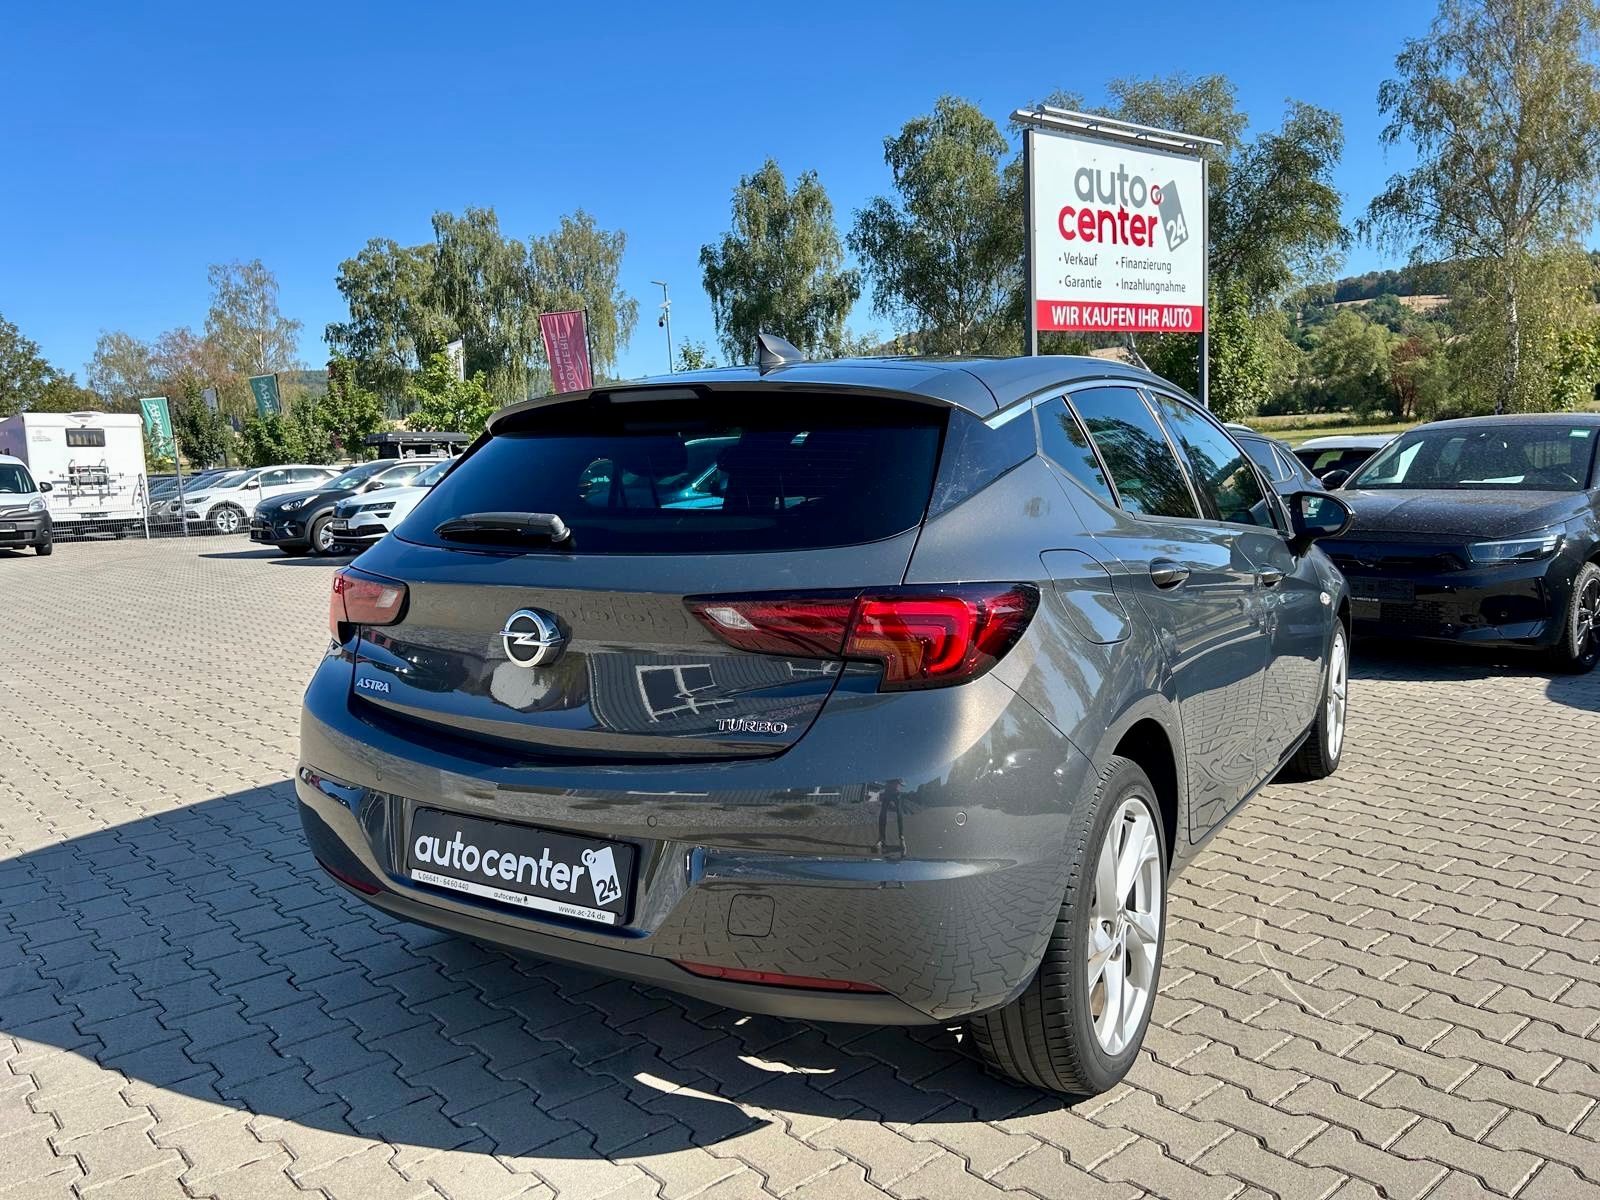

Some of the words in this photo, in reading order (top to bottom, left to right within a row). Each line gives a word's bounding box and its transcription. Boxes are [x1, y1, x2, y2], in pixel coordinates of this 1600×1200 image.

[1074, 163, 1147, 208] auto
[1058, 204, 1157, 247] center
[1166, 213, 1187, 248] 24
[1063, 252, 1098, 267] Verkauf
[1121, 257, 1171, 274] Finanzierung
[1065, 275, 1102, 288] Garantie
[1121, 278, 1186, 294] Inzahlungnahme
[1052, 305, 1079, 326] WIR
[1083, 306, 1135, 327] KAUFEN
[1138, 309, 1159, 327] IHR
[1161, 308, 1192, 328] AUTO
[356, 677, 390, 693] ASTRA
[716, 718, 788, 734] TURBO
[414, 831, 584, 894] autocenter
[595, 874, 618, 902] 24
[494, 892, 522, 903] autocenter
[558, 905, 606, 921] www.ac-24.de
